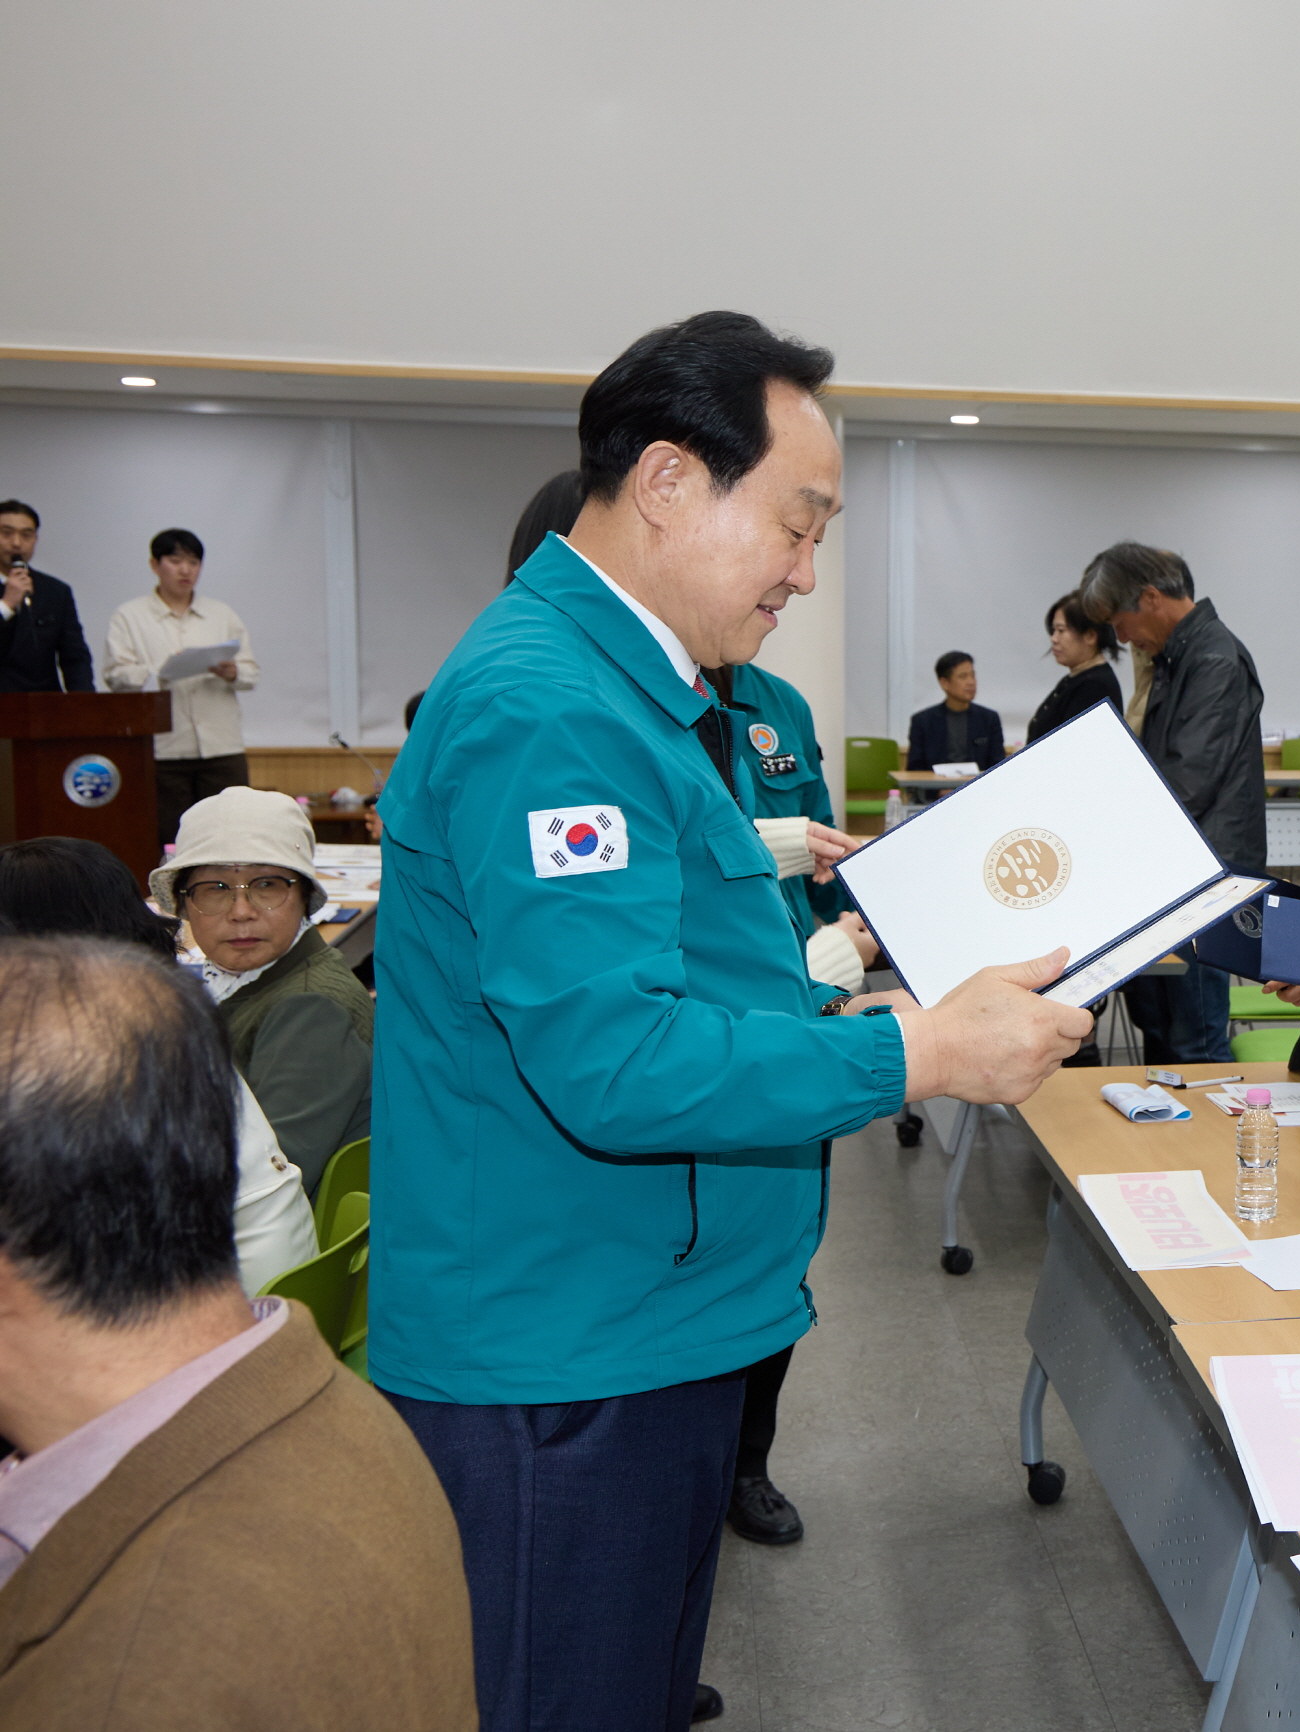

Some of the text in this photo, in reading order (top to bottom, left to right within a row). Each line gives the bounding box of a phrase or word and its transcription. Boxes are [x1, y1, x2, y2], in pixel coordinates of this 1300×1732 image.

[992, 831, 1069, 905] THE LAND OF SEA TONGYEONG
